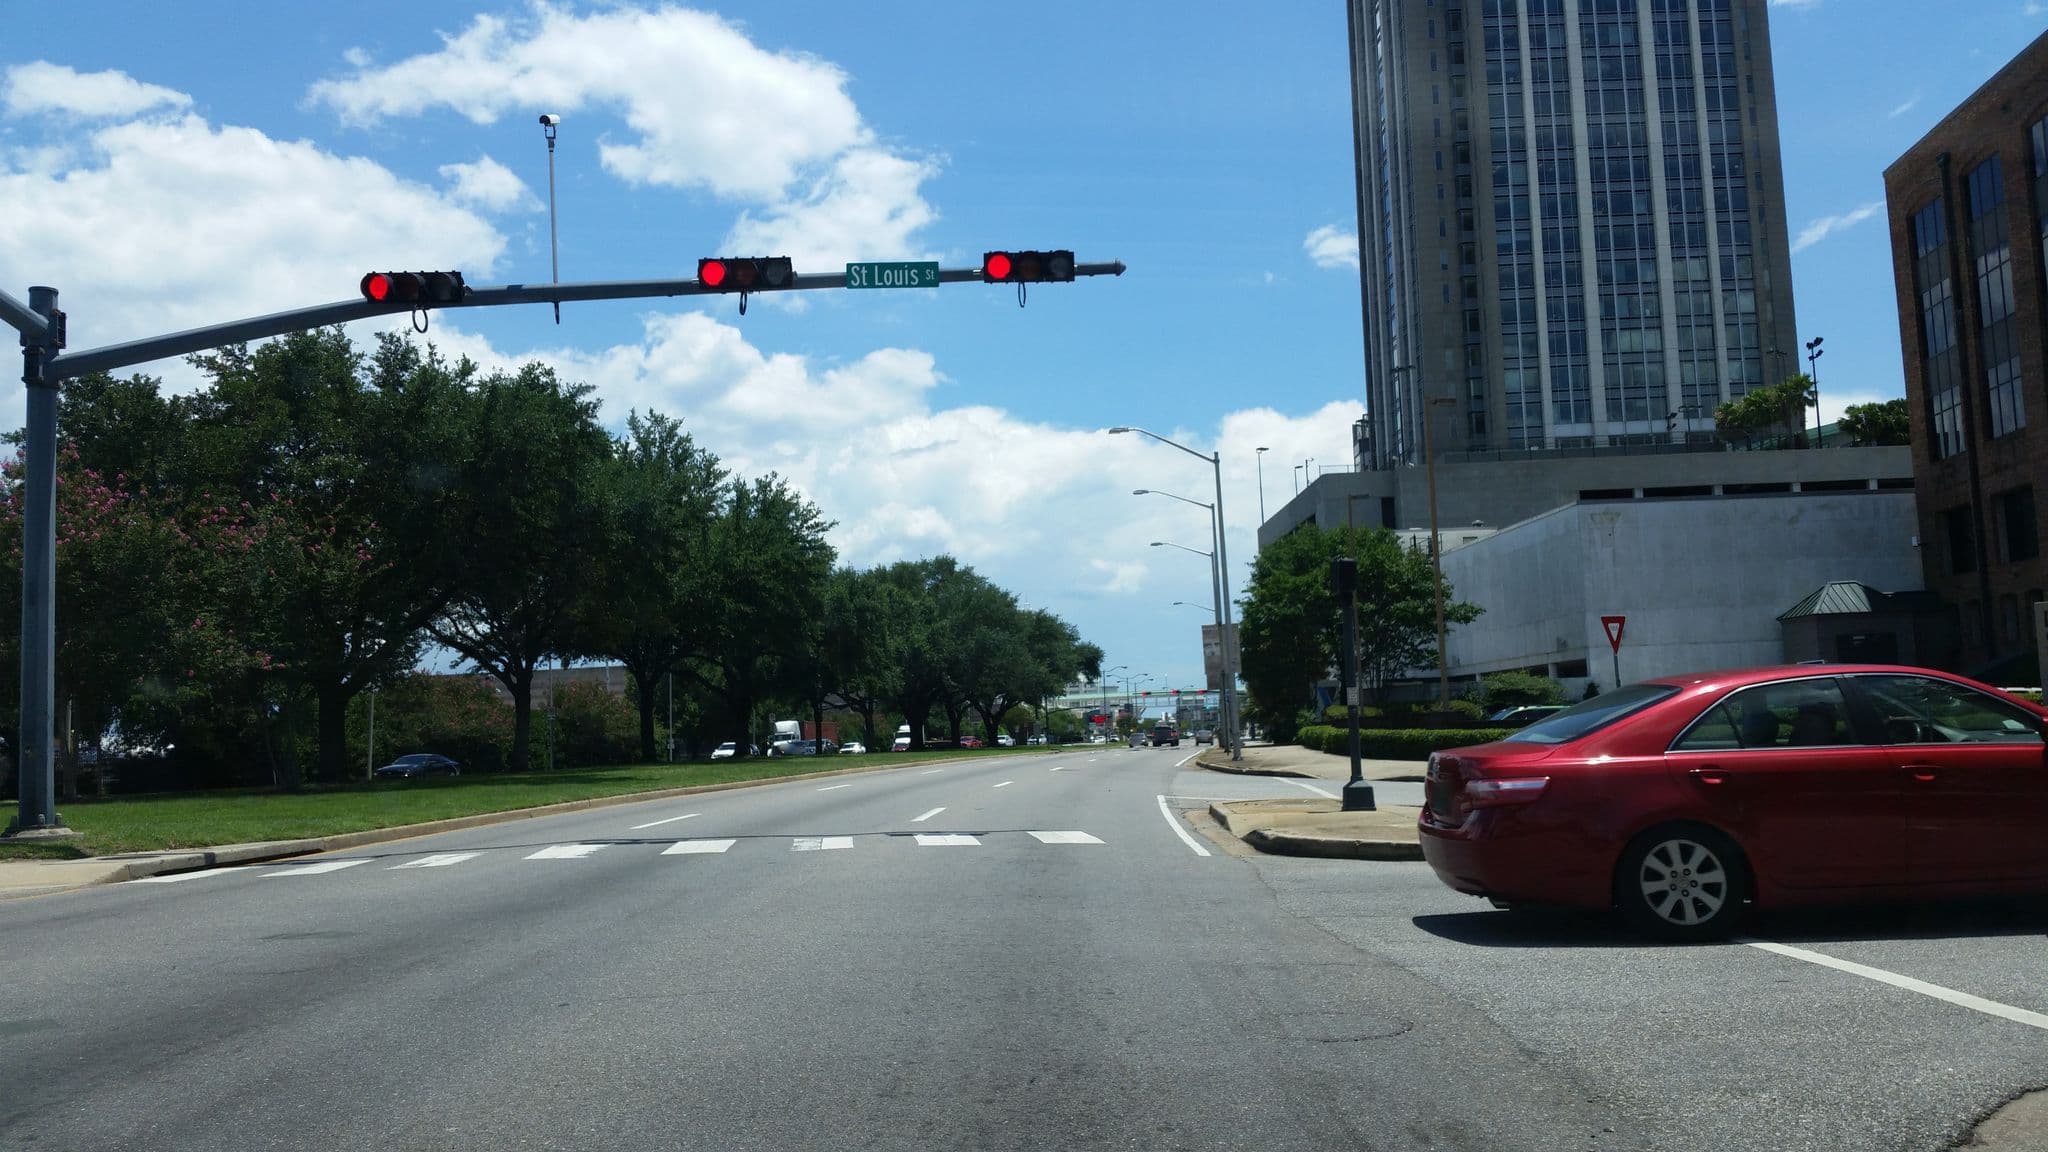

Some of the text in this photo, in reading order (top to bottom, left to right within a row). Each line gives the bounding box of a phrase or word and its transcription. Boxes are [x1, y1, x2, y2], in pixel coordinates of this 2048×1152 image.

[851, 265, 935, 286] St Louis St
